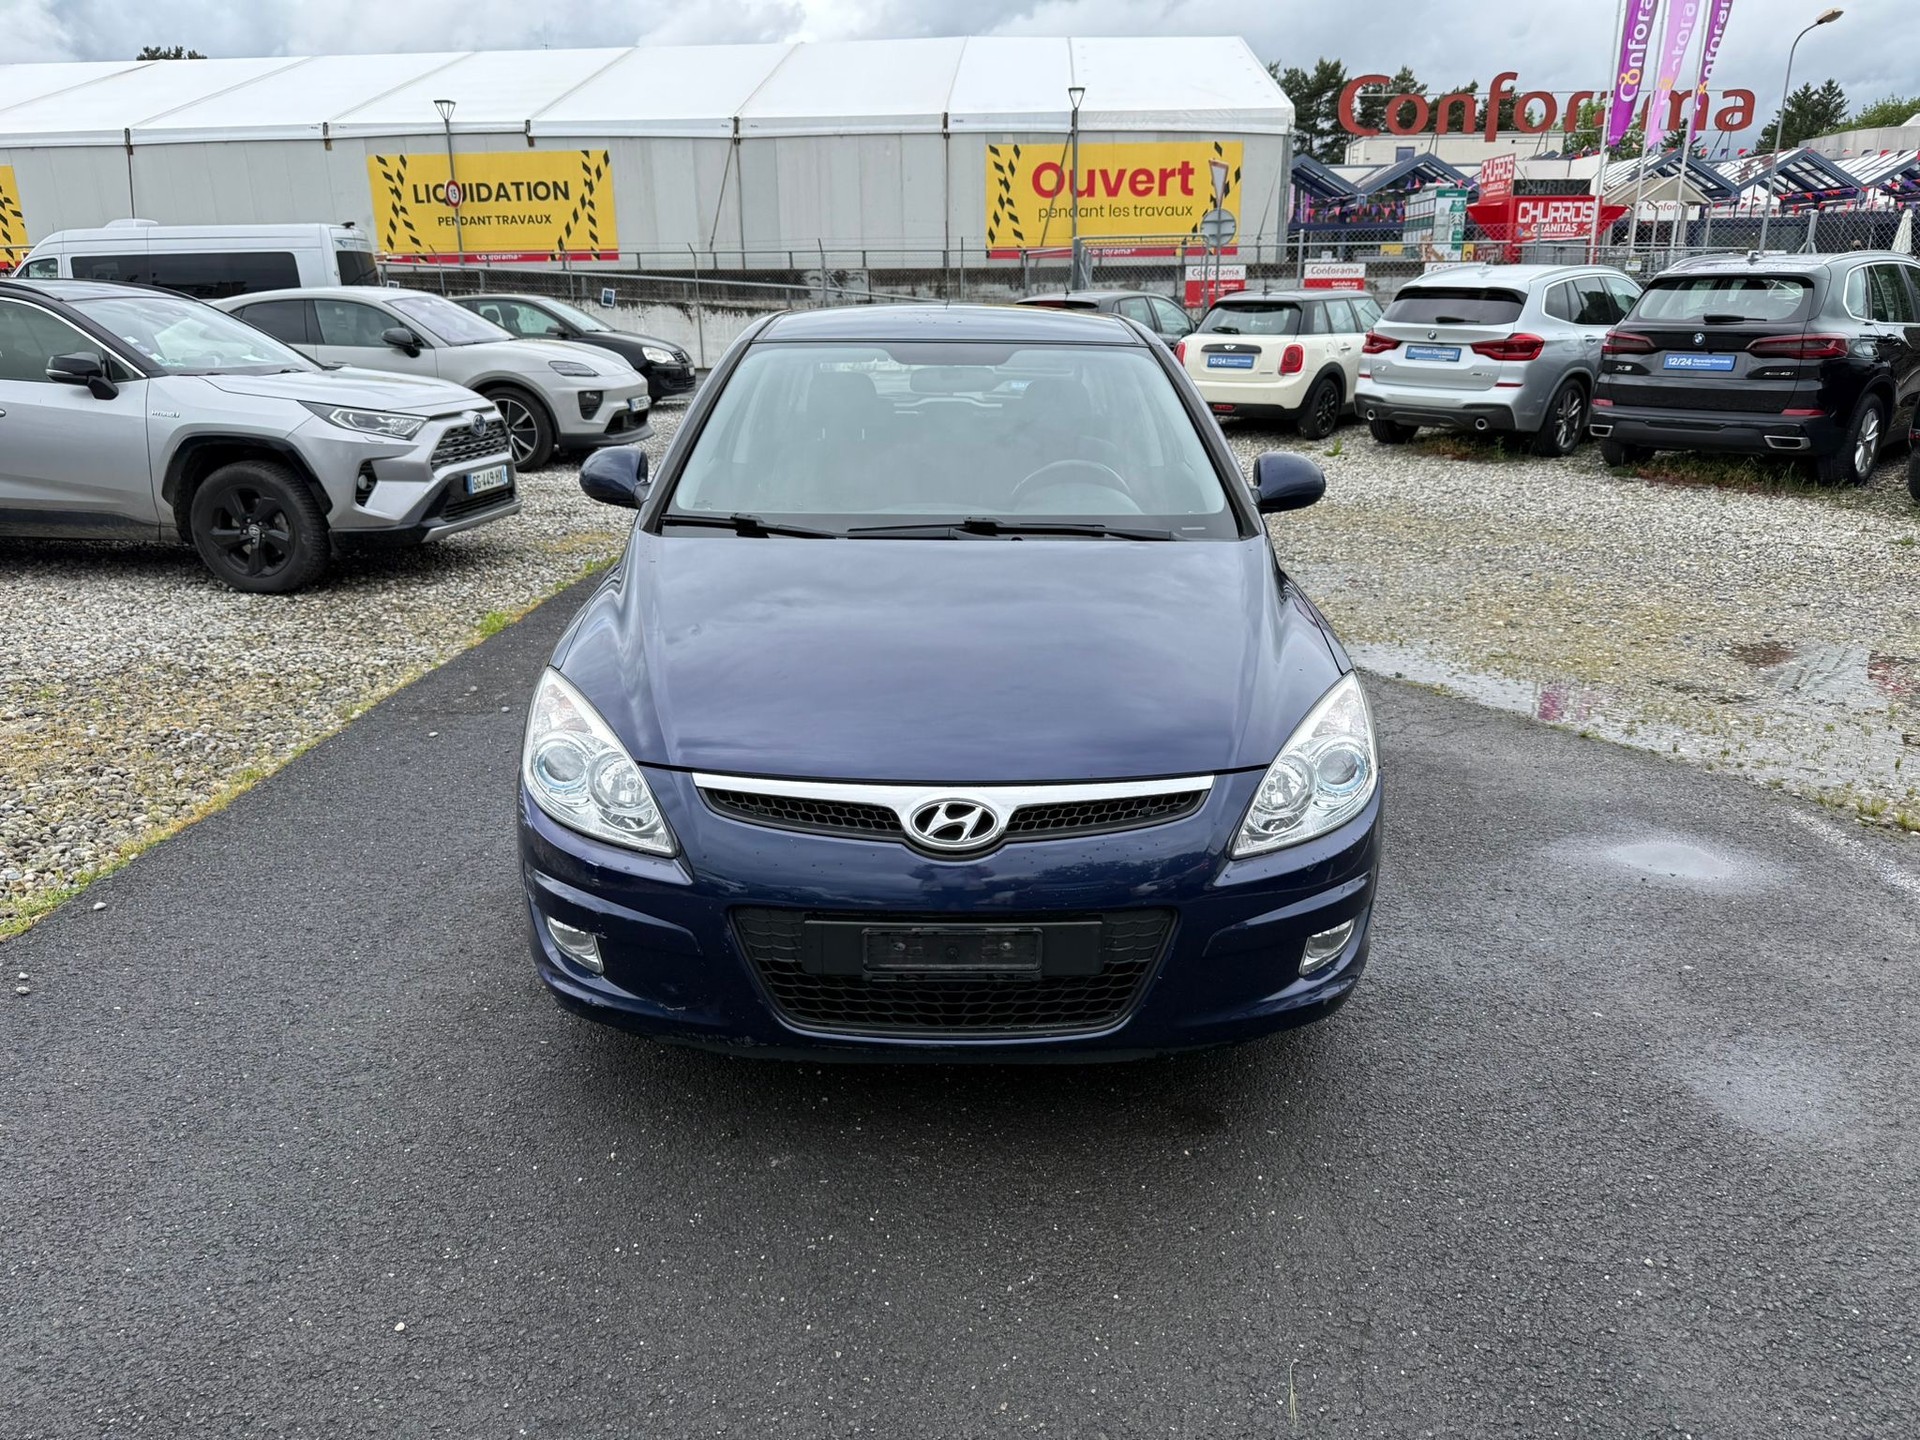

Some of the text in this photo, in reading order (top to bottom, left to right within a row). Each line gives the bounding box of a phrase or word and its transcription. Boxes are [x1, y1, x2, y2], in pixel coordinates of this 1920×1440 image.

[1032, 160, 1195, 199] Ouvert
[1038, 204, 1193, 222] pendant les travaux
[1518, 201, 1595, 223] CHURROS
[437, 214, 552, 226] PENDANT TRAVAUX
[1192, 267, 1240, 277] Cofoama
[1311, 266, 1360, 275] Conforama
[1667, 357, 1692, 366] 12/24
